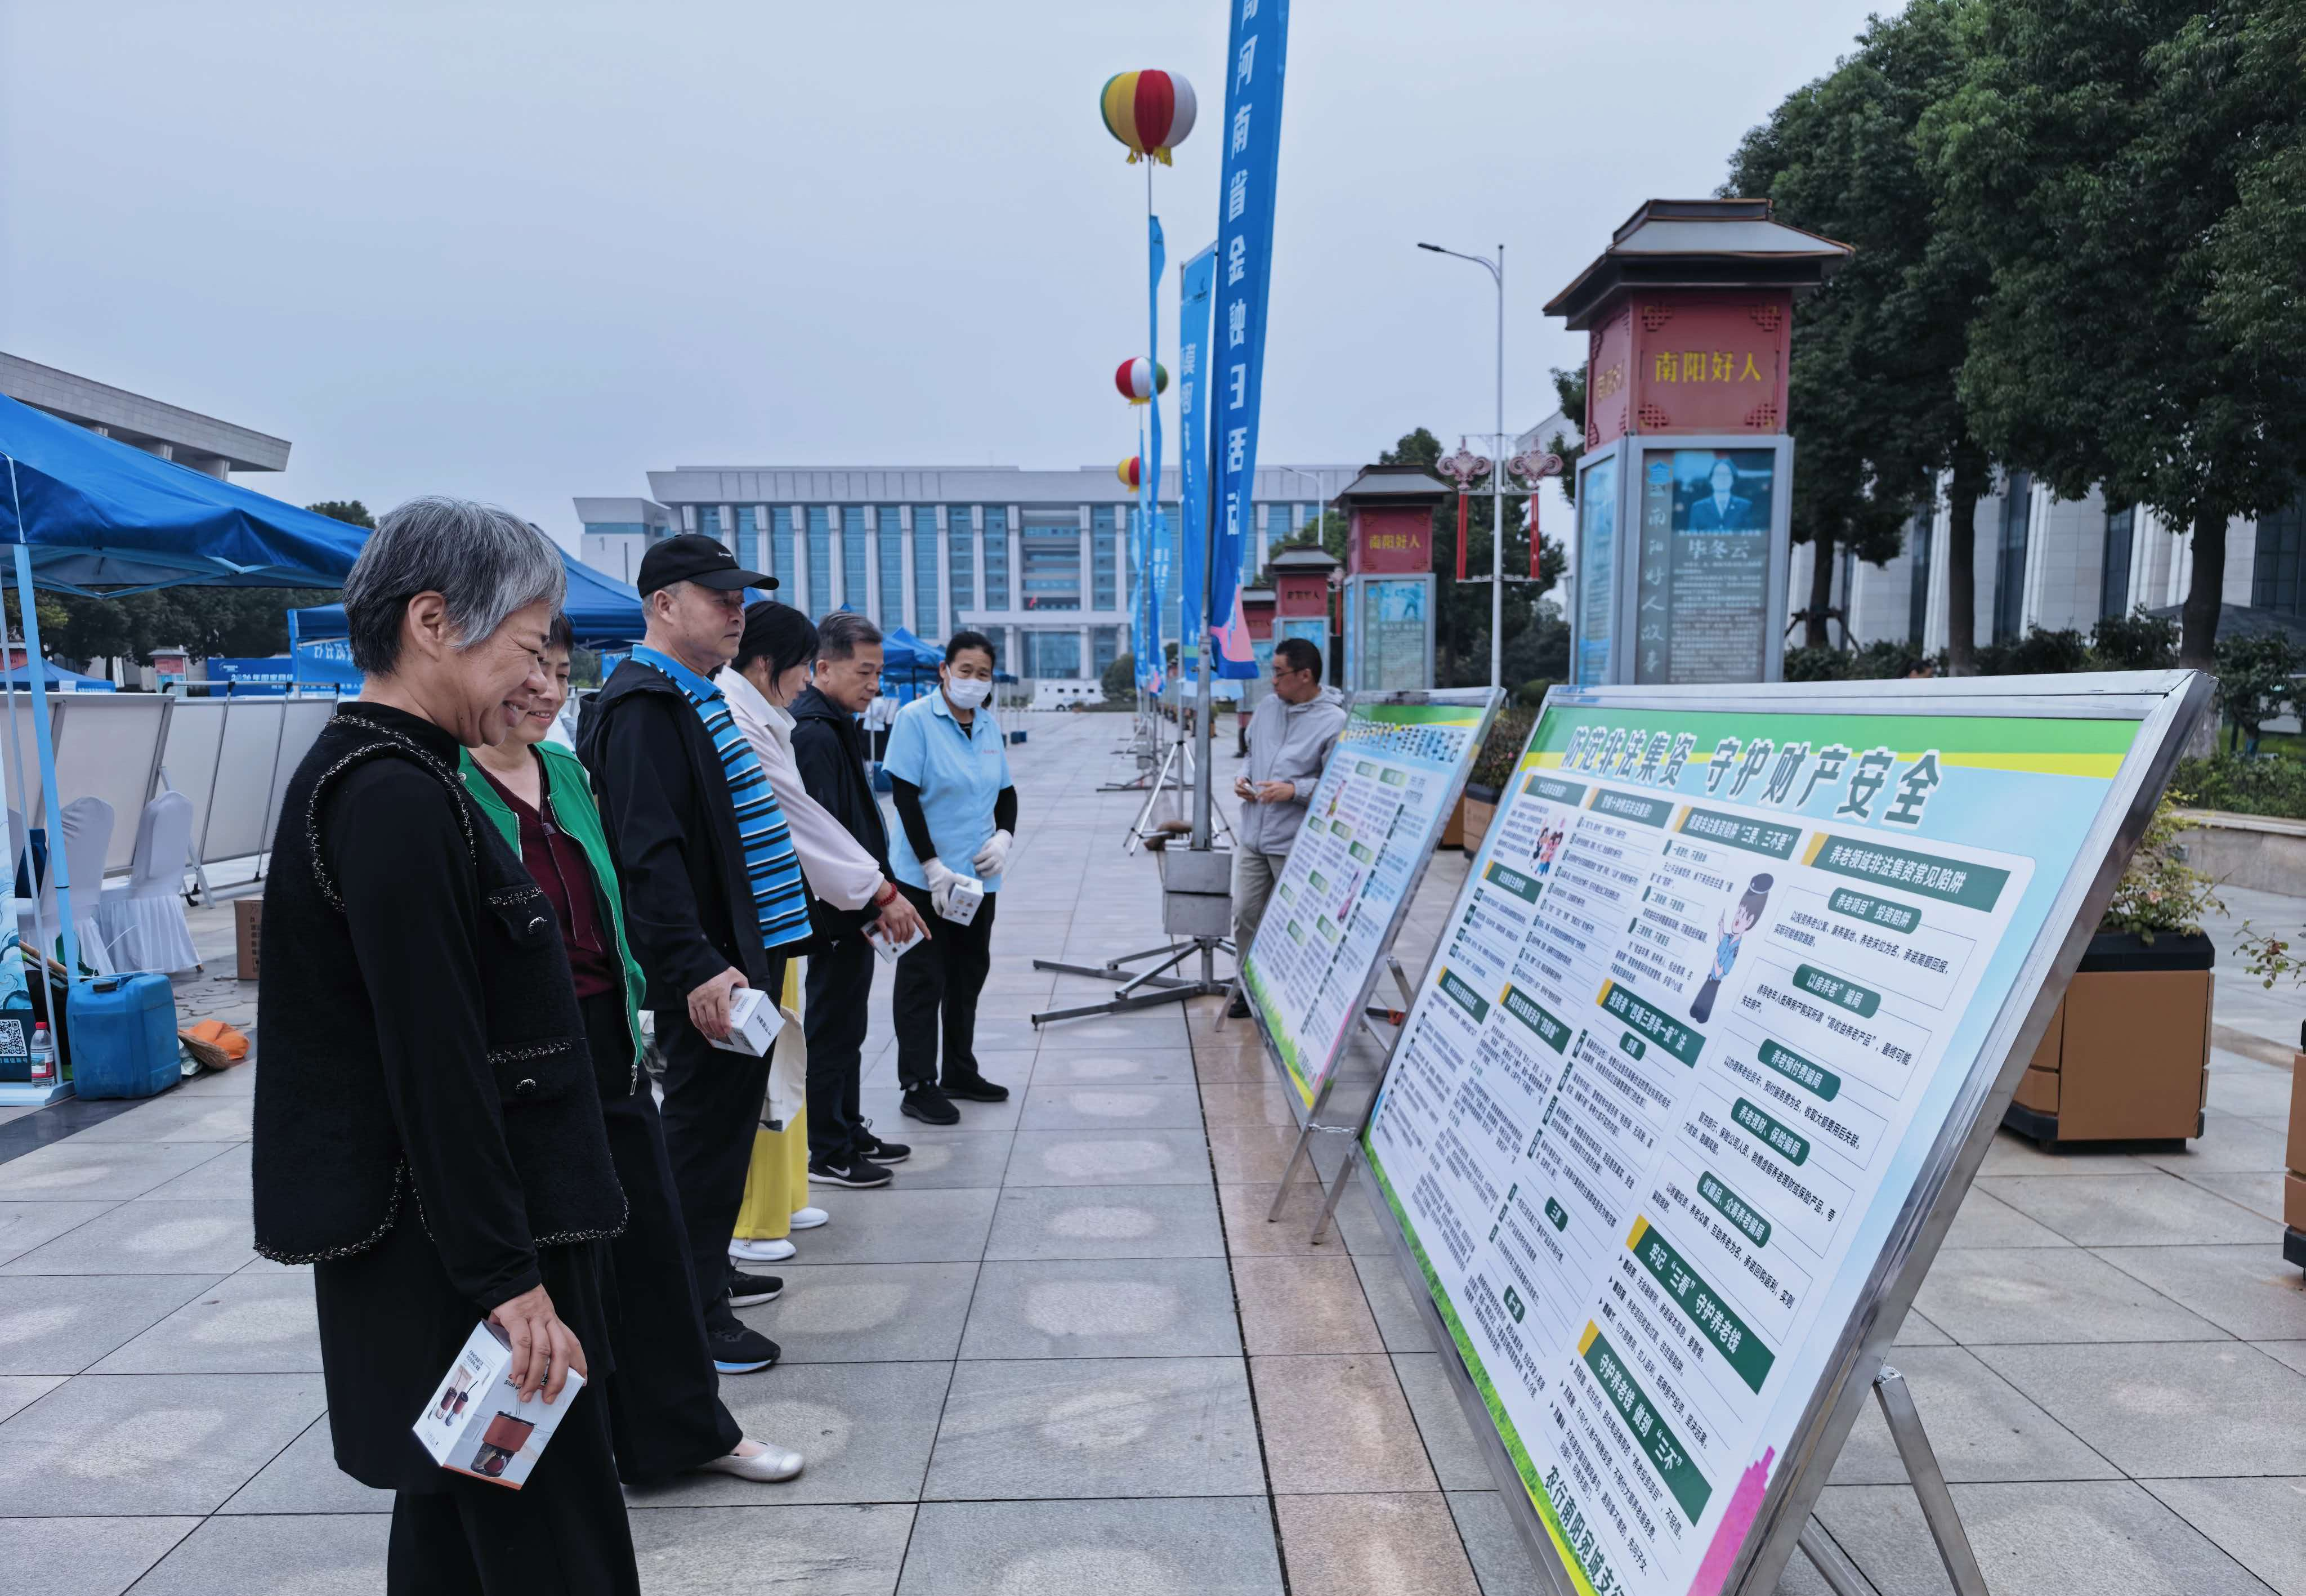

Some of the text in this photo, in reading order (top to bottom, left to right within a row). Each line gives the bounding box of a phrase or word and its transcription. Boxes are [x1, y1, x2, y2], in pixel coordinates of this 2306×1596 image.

[1655, 351, 1762, 383] 南阳好人
[1563, 727, 1939, 822] 防范非法集资 守护财产安全
[1827, 843, 1968, 897] 养老领域非法集资常见陷阱
[1608, 988, 1688, 1054] 投资者“四看三思等一夜”法
[1740, 994, 1765, 1014] 失去房产。
[1625, 1037, 1639, 1054] 四看
[1769, 1048, 1824, 1091] 养老预付费骗局
[1737, 1104, 1802, 1159] 养老理财、保险骗局
[1550, 1204, 1561, 1223] 三思
[1701, 1176, 1766, 1242] 收藏品、众筹养老骗局
[1507, 1290, 1521, 1318] 等一夜
[1597, 1351, 1682, 1481] 守护养老钱 做到“三不”
